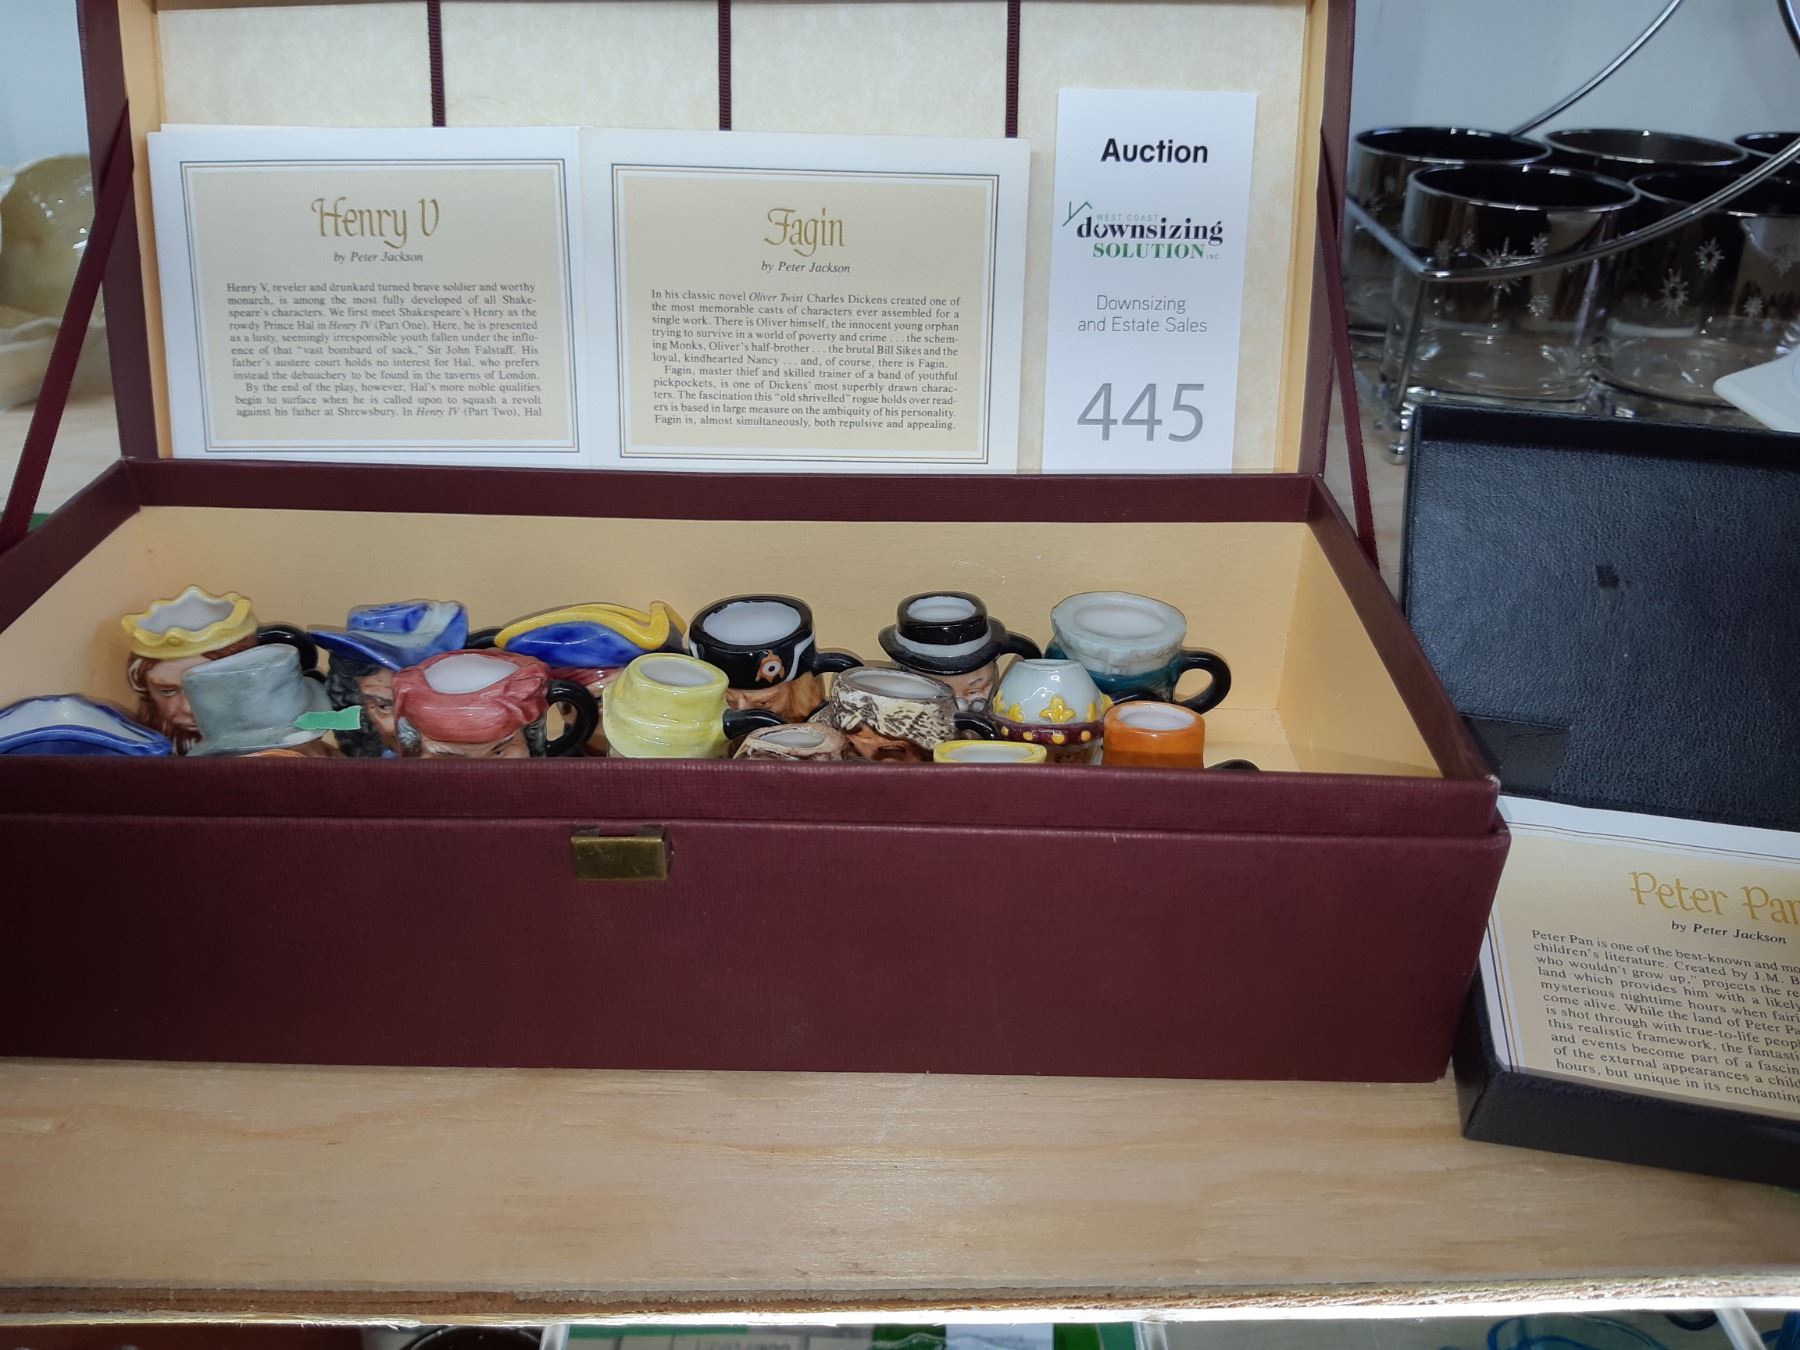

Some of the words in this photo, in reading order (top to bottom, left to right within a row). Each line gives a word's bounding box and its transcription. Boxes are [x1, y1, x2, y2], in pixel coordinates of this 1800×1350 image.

[1100, 138, 1208, 163] Auction
[311, 196, 407, 249] Henry
[418, 198, 440, 236] V
[1126, 214, 1159, 222] COAST
[764, 208, 846, 257] Fagin
[1077, 216, 1223, 246] downsizing
[334, 252, 346, 264] by
[350, 251, 378, 262] Peter
[381, 251, 424, 262] Jackson
[1093, 242, 1205, 259] SOLUTION
[761, 261, 774, 274] by
[778, 261, 806, 272] Peter
[809, 262, 850, 274] Jackson
[226, 283, 257, 293] Henry
[272, 283, 306, 291] reveler
[309, 282, 326, 291] and
[329, 282, 375, 291] drunkard
[377, 282, 410, 291] turned
[413, 282, 440, 291] brave
[442, 282, 476, 290] soldier
[479, 282, 497, 290] and
[499, 282, 535, 293] worthy
[651, 289, 661, 298] In
[664, 290, 679, 298] his
[682, 290, 715, 299] classic
[718, 292, 746, 300] novel
[748, 292, 777, 301] Oliver
[780, 292, 803, 301] Twist
[806, 293, 844, 302] Charles
[847, 294, 887, 304] Dickens
[890, 296, 926, 304] created
[949, 297, 960, 305] of
[293, 298, 325, 306] among
[330, 295, 346, 304] the
[382, 295, 405, 306] fully
[410, 295, 462, 306] developed
[467, 295, 479, 304] of
[483, 295, 496, 304] all
[502, 295, 536, 303] Shake-
[651, 302, 666, 310] the
[699, 304, 754, 313] memorable
[787, 305, 798, 314] of
[800, 306, 852, 315] characters
[881, 308, 932, 317] assembled
[936, 309, 950, 317] for
[1096, 295, 1186, 314] Downsizing
[328, 308, 344, 316] We
[347, 308, 368, 316] first
[473, 307, 504, 318] Henry
[521, 307, 536, 316] the
[229, 321, 259, 331] rowdy
[263, 321, 294, 329] Prince
[296, 321, 314, 329] Hal
[328, 320, 356, 331] Henry
[374, 320, 399, 331] (Part
[463, 320, 475, 329] he
[489, 320, 537, 331] presented
[652, 315, 680, 326] single
[713, 316, 743, 325] There
[756, 317, 788, 326] Oliver
[831, 319, 846, 328] the
[849, 320, 891, 329] innocent
[894, 323, 923, 332] young
[924, 322, 958, 332] orphan
[1078, 317, 1106, 332] and
[1112, 317, 1160, 332] Estate
[1166, 317, 1208, 332] Sales
[736, 367, 759, 376] thief
[762, 368, 779, 376] and
[783, 368, 815, 377] skilled
[818, 369, 851, 378] trainer
[854, 370, 866, 378] of
[877, 370, 901, 379] band
[904, 370, 915, 379] of
[918, 371, 957, 382] youthful
[1077, 382, 1204, 442] 445
[1629, 871, 1729, 916] Peter
[1671, 920, 1686, 932] by
[1693, 923, 1728, 936] Peter
[1733, 928, 1787, 944] Jackson
[1532, 929, 1565, 942] Peter
[1569, 934, 1593, 946] Pan
[1596, 938, 1607, 948] is
[1610, 942, 1633, 951] one
[1636, 943, 1649, 953] of
[1652, 945, 1672, 956] the
[1675, 948, 1751, 967] best-known
[1754, 960, 1778, 971] and
[1536, 955, 1563, 966] who
[1632, 969, 1663, 979] grow
[1702, 978, 1756, 992] projects
[1760, 984, 1781, 995] the
[1674, 959, 1726, 975] Created
[1731, 967, 1747, 981] by
[1538, 965, 1566, 978] land
[1573, 972, 1613, 985] which
[1620, 979, 1677, 993] provides
[1683, 985, 1708, 997] him
[1715, 991, 1745, 1002] with
[1540, 981, 1615, 998] mysterious
[1620, 991, 1682, 1007] nighttime
[1687, 998, 1726, 1013] hours
[1731, 1006, 1768, 1018] when
[1543, 993, 1579, 1005] come
[1624, 1002, 1664, 1017] While
[1667, 1009, 1688, 1020] the
[1692, 1011, 1722, 1025] land
[1726, 1017, 1740, 1027] of
[1745, 1018, 1780, 1032] Peter
